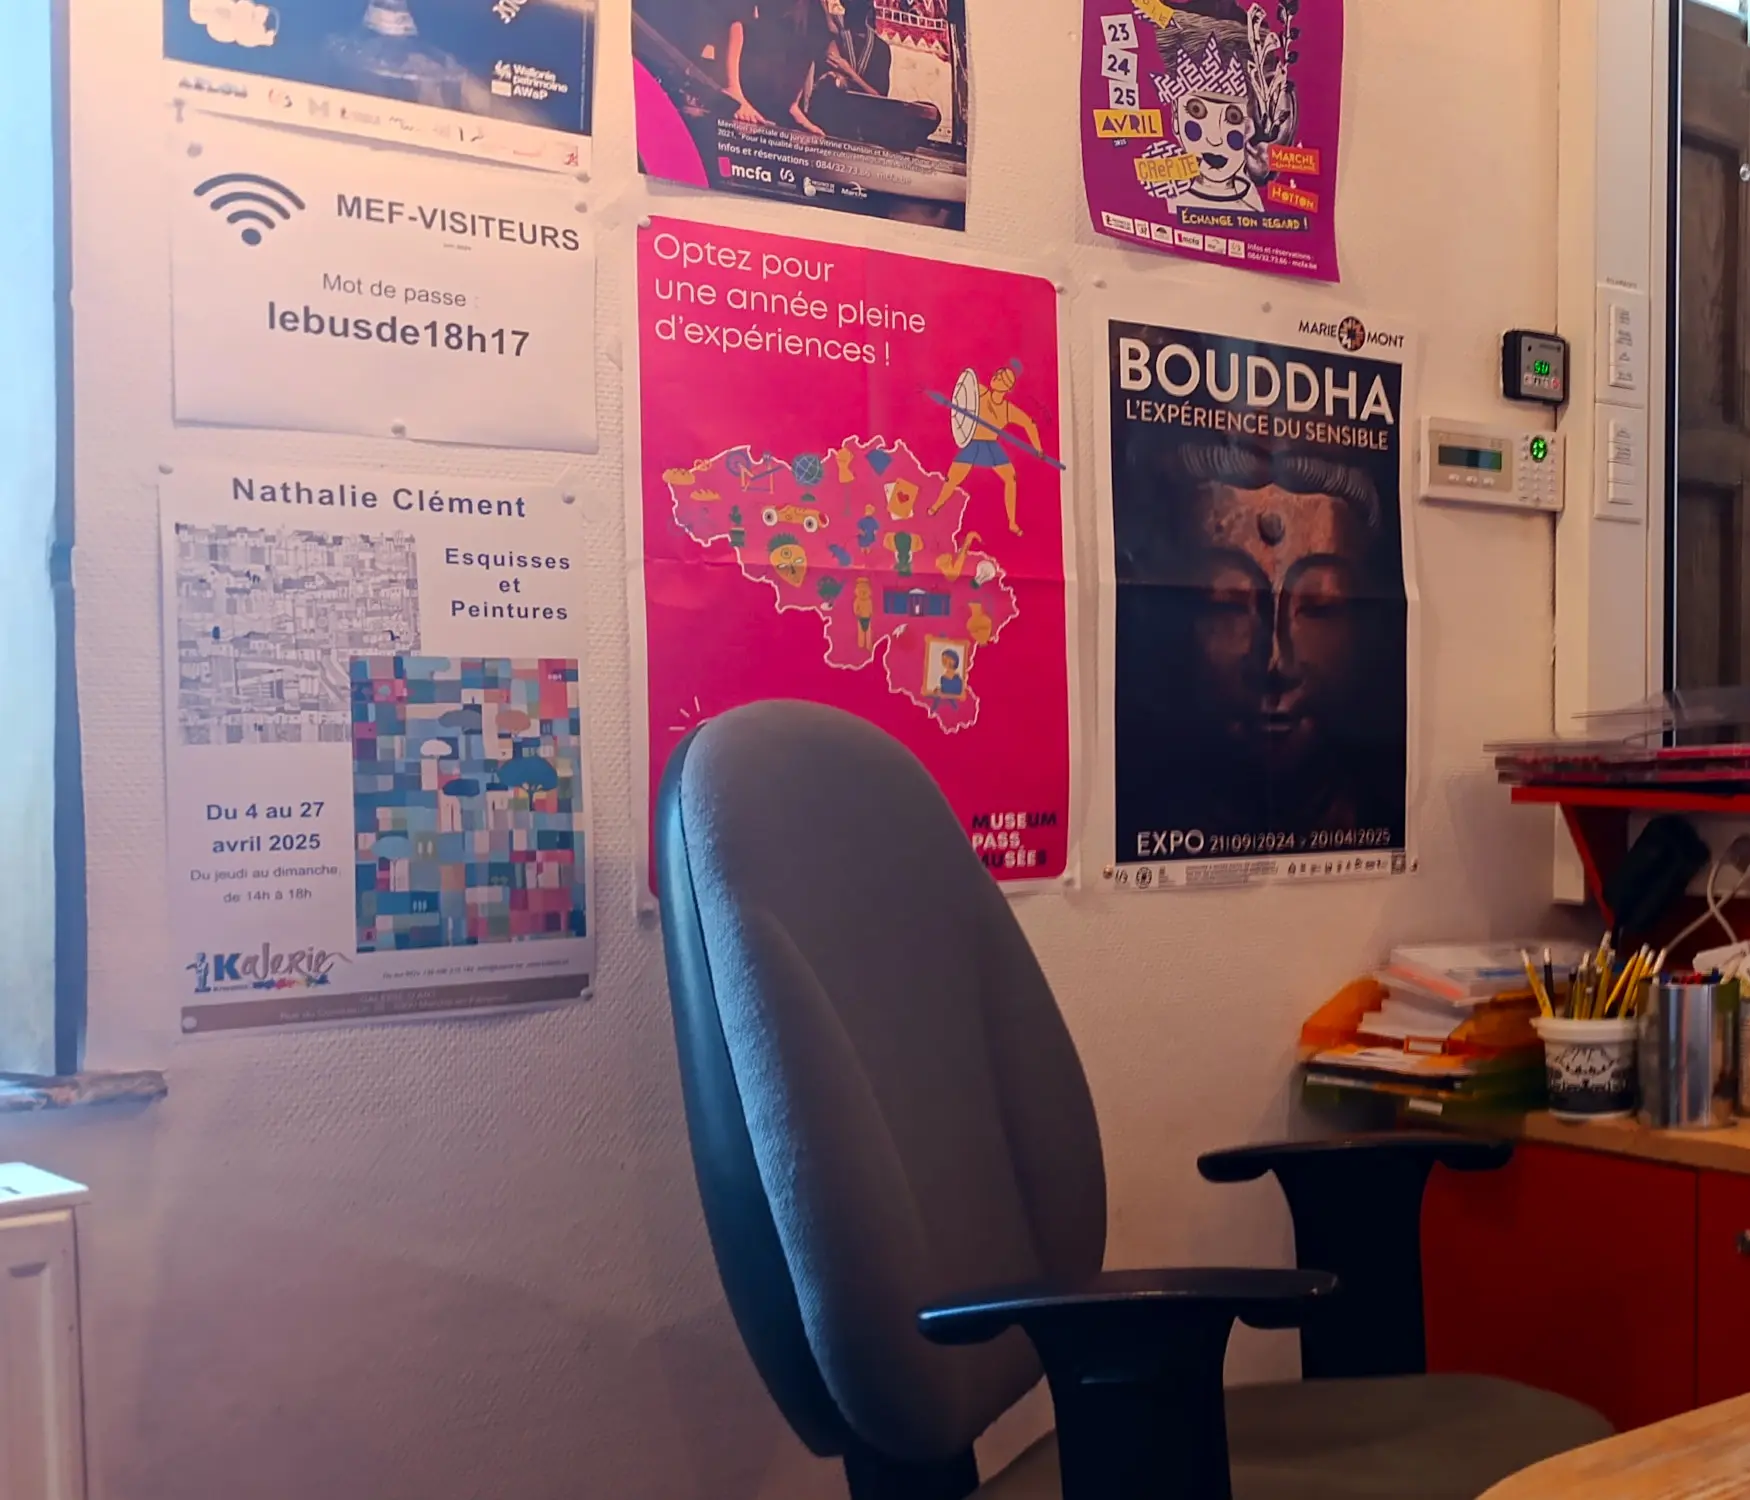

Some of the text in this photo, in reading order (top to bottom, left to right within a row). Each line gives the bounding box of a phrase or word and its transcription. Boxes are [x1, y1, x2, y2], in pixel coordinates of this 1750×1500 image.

[1108, 23, 1130, 42] 23
[1107, 54, 1130, 75] 24
[1114, 87, 1136, 106] 25
[1102, 114, 1157, 134] AVRIL
[718, 142, 740, 153] Infos
[742, 146, 751, 155] et
[754, 149, 809, 167] réservations
[732, 164, 771, 182] mcfa
[336, 194, 580, 251] MEF-VISITEURS
[1181, 206, 1233, 227] ÉCHANGE
[1238, 215, 1258, 228] TON
[1262, 217, 1300, 230] REGARD
[654, 233, 834, 282] Optez pour
[322, 272, 364, 296] Mot
[370, 280, 397, 299] de
[404, 287, 467, 308] passe
[655, 279, 927, 333] une année pleine
[267, 301, 530, 357] lebusde18h17
[655, 315, 891, 365] d'expériences !
[1299, 320, 1404, 348] MARIE MONT
[1118, 338, 1394, 424] BOUDDHA
[1125, 399, 1388, 451] L'EXPÉRIENCE DU SENSIBLE
[231, 477, 527, 518] Nathalie Clément
[444, 547, 571, 571] Esquisses
[499, 576, 521, 594] et
[451, 600, 568, 622] Peintures
[206, 801, 325, 820] Du 4 au 27
[972, 812, 1057, 830] MUSEUM
[212, 833, 321, 853] avril 2025
[972, 831, 1020, 850] PASS
[1137, 829, 1204, 857] EXPO
[190, 869, 211, 881] Du
[214, 868, 248, 883] jeudi
[252, 868, 269, 878] au
[223, 892, 241, 903] de
[247, 890, 270, 902] 14h
